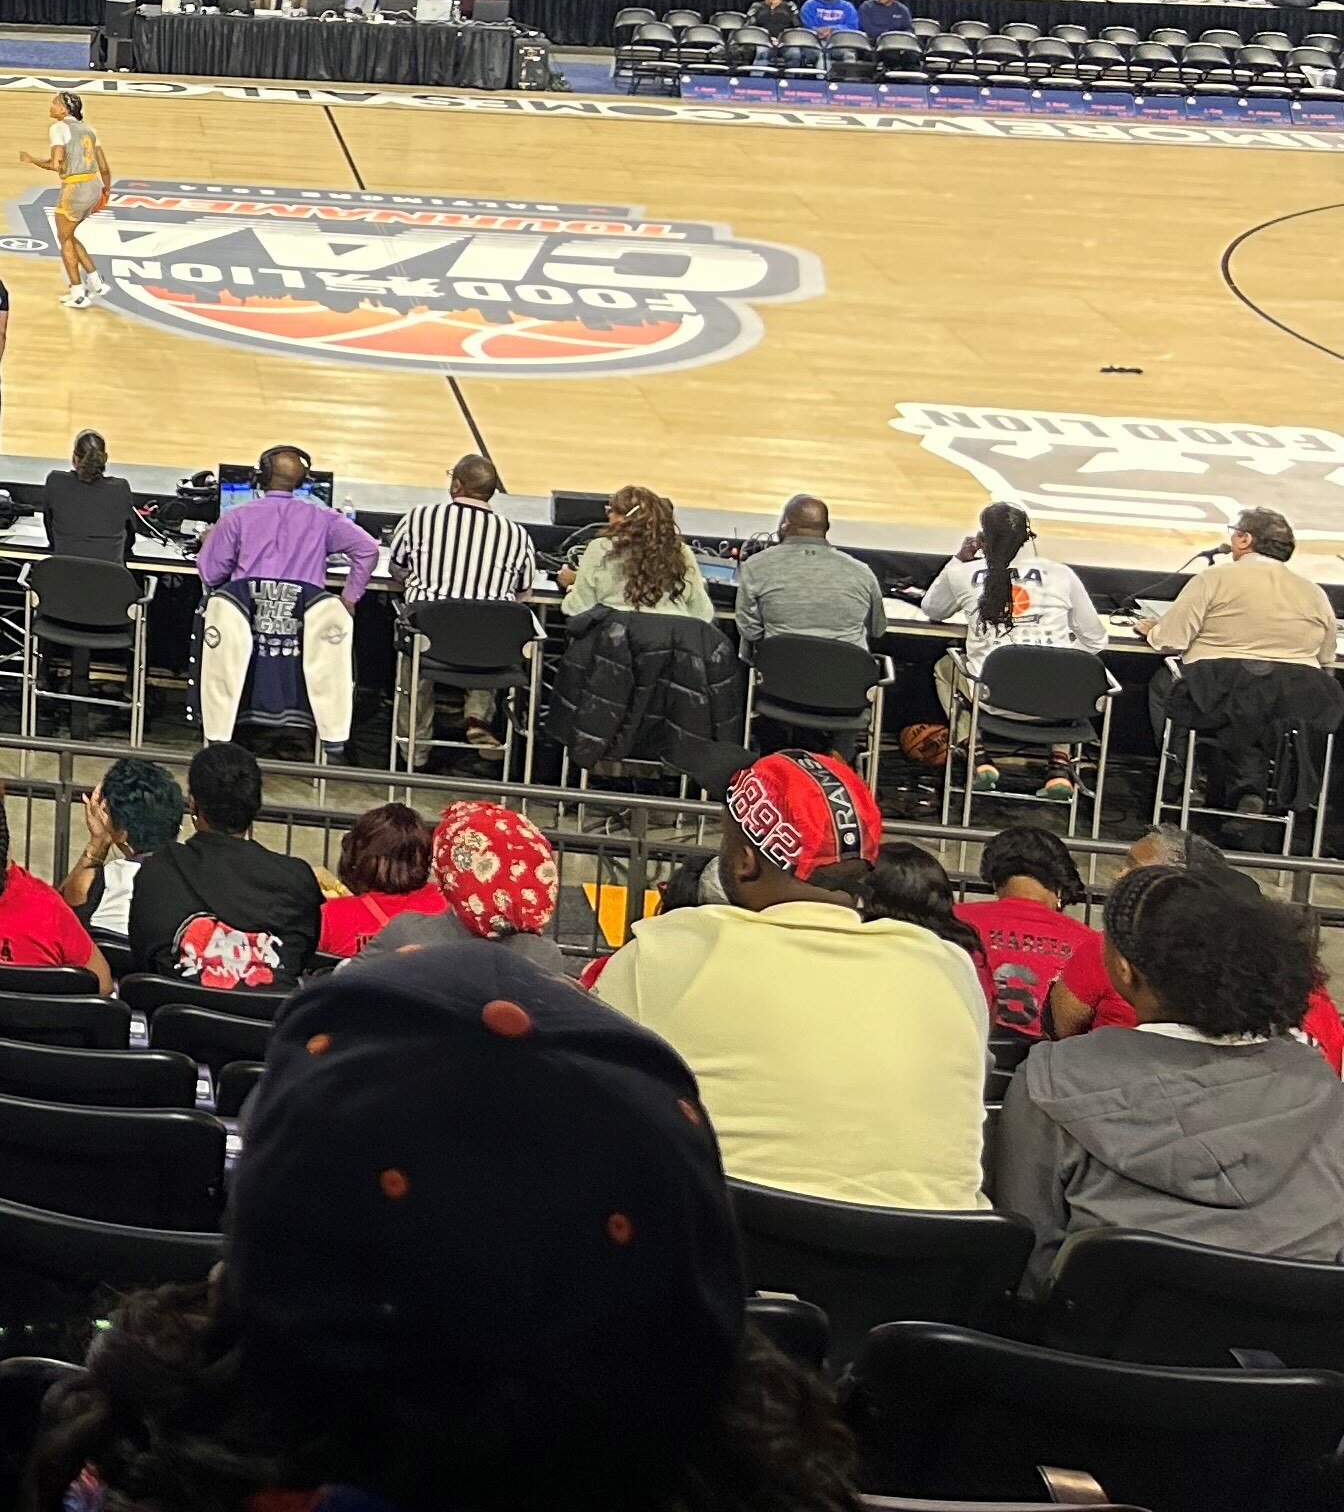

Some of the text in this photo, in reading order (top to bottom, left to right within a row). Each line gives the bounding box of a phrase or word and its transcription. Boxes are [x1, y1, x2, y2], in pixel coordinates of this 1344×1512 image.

[212, 86, 380, 103] ALL
[100, 194, 689, 239] TOURNAMEN
[304, 191, 560, 211] BALTIMORE
[108, 258, 700, 313] FOOD LION
[919, 408, 1338, 454] FOOD LION
[247, 579, 304, 602] LIVE
[253, 599, 297, 618] THE
[797, 751, 858, 833] RAMS
[993, 962, 1040, 1025] 6
